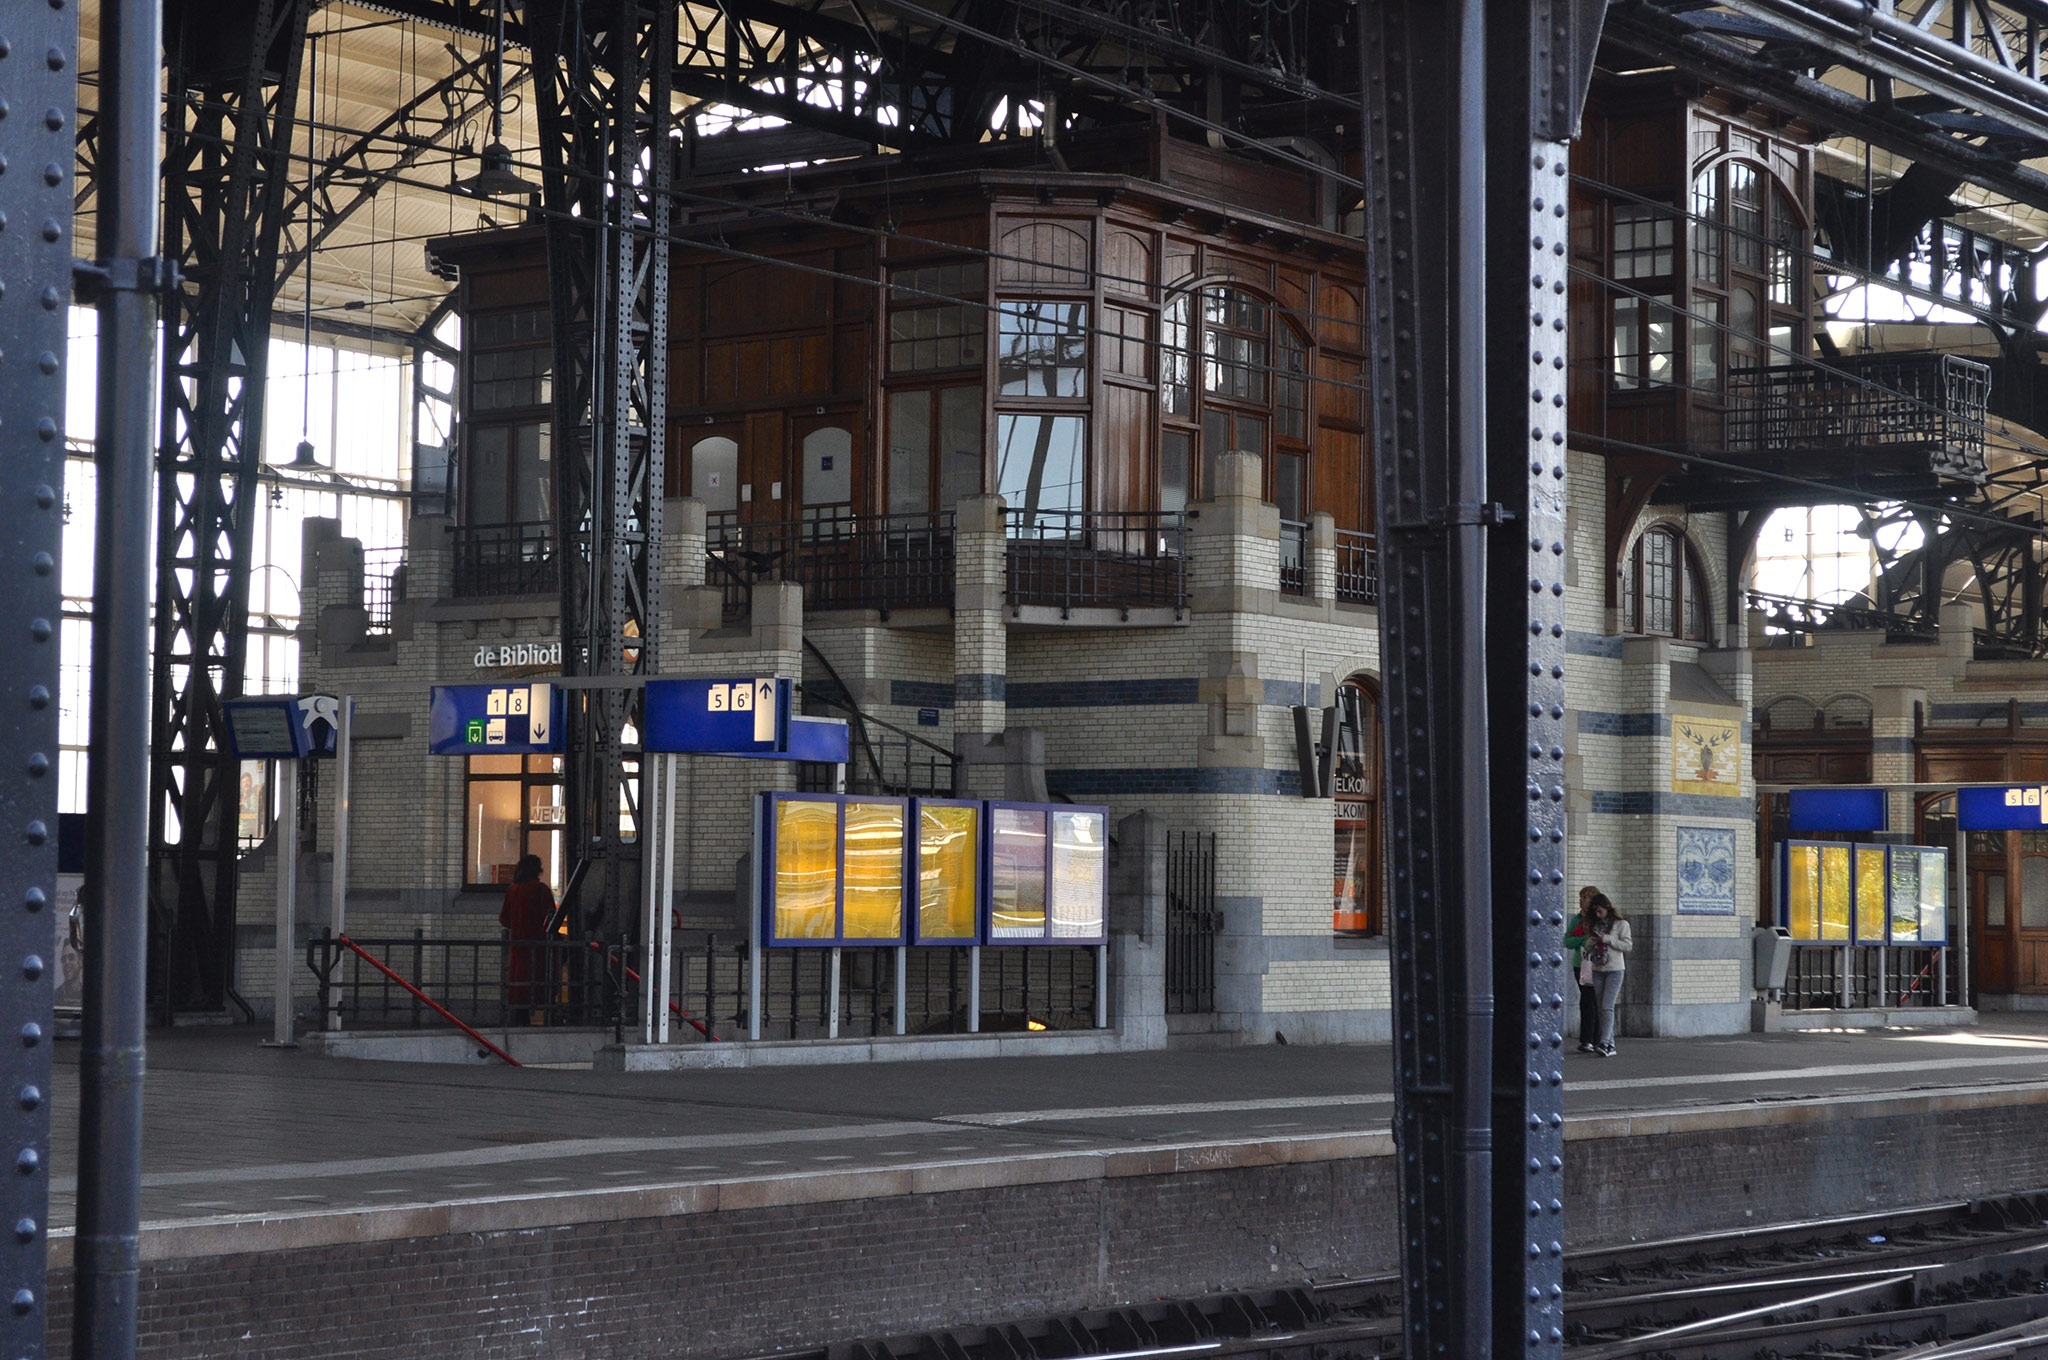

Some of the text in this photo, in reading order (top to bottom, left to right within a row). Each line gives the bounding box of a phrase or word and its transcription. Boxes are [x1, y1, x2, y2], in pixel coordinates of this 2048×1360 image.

[474, 646, 497, 667] de
[494, 698, 522, 713] 1 8
[715, 694, 722, 708] 5
[1334, 777, 1371, 793] ELKOM
[2011, 795, 2016, 804] 5
[1334, 804, 1366, 818] LKOM
